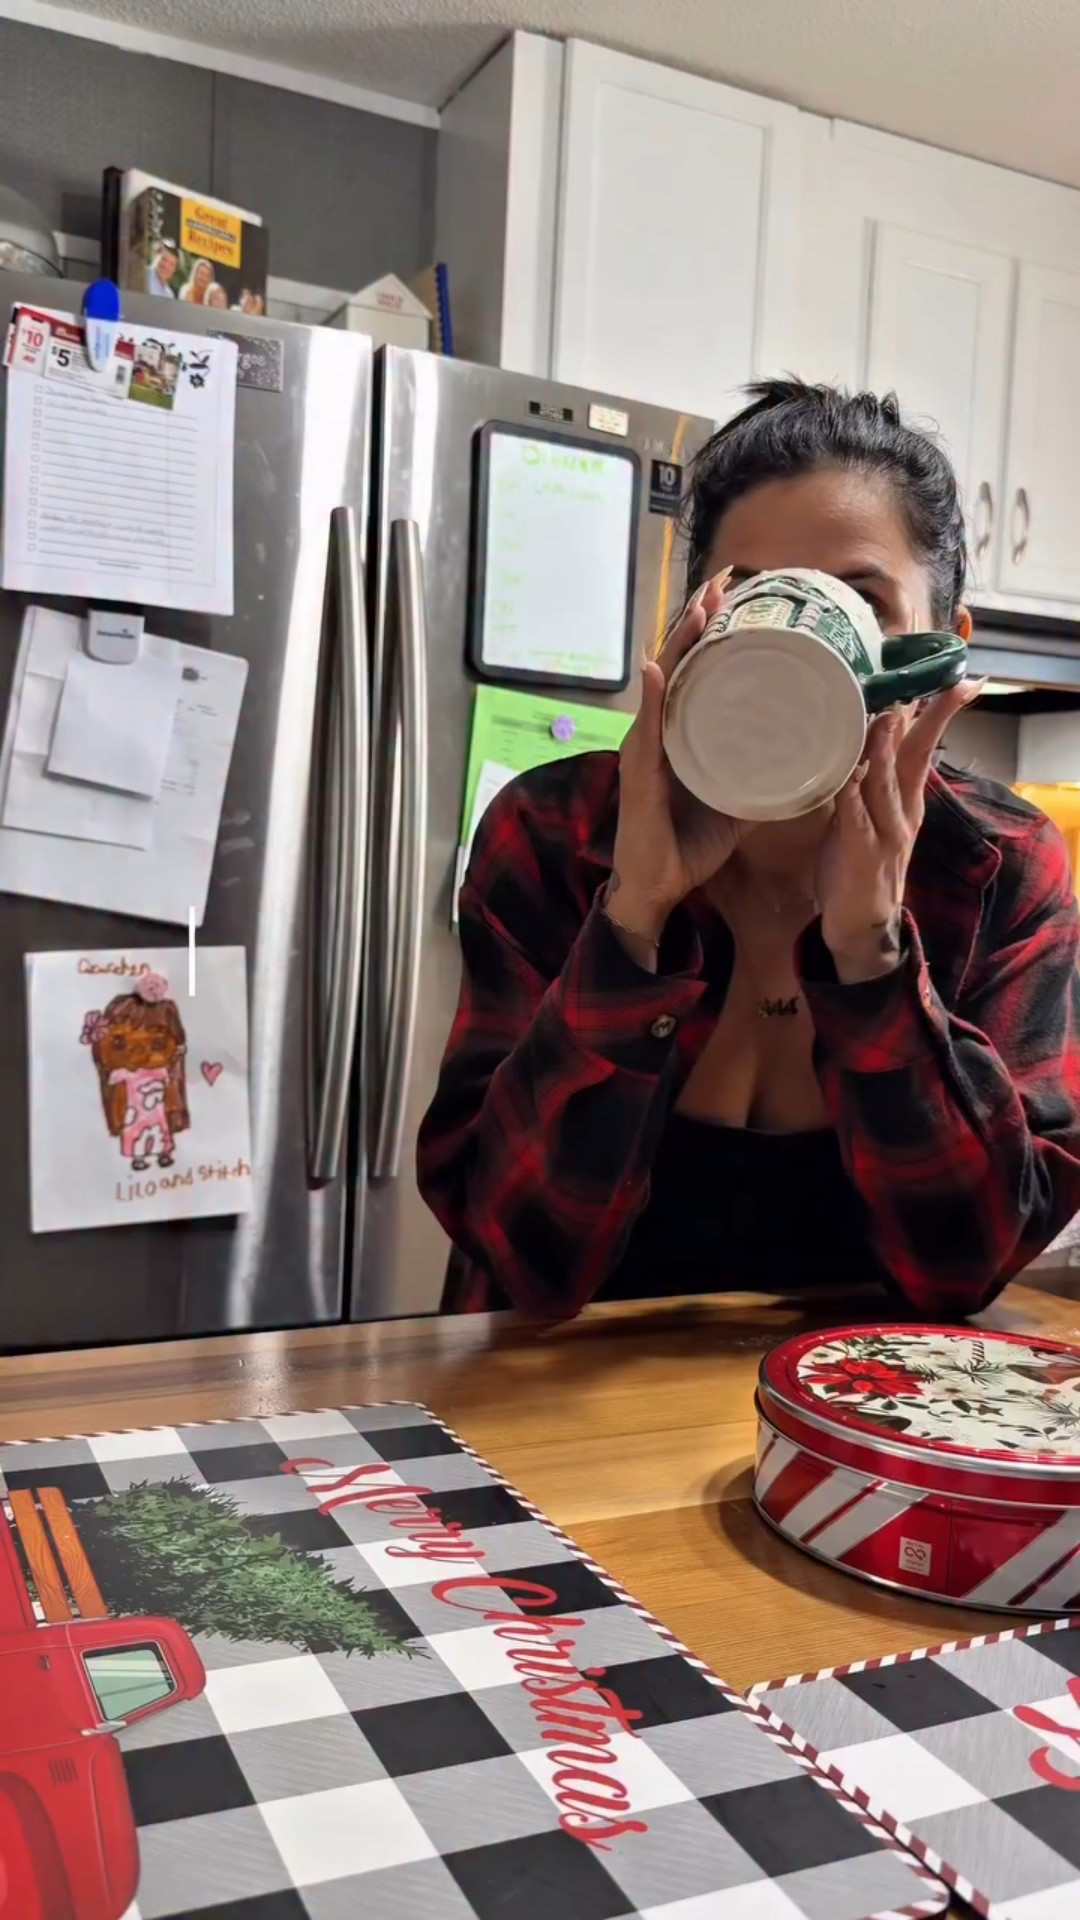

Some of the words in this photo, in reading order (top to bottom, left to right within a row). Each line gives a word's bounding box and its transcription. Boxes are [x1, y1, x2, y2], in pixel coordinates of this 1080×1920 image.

[659, 464, 676, 486] 10
[161, 1167, 193, 1189] and
[279, 1457, 486, 1564] Merry
[431, 1577, 649, 1851] Christmas
